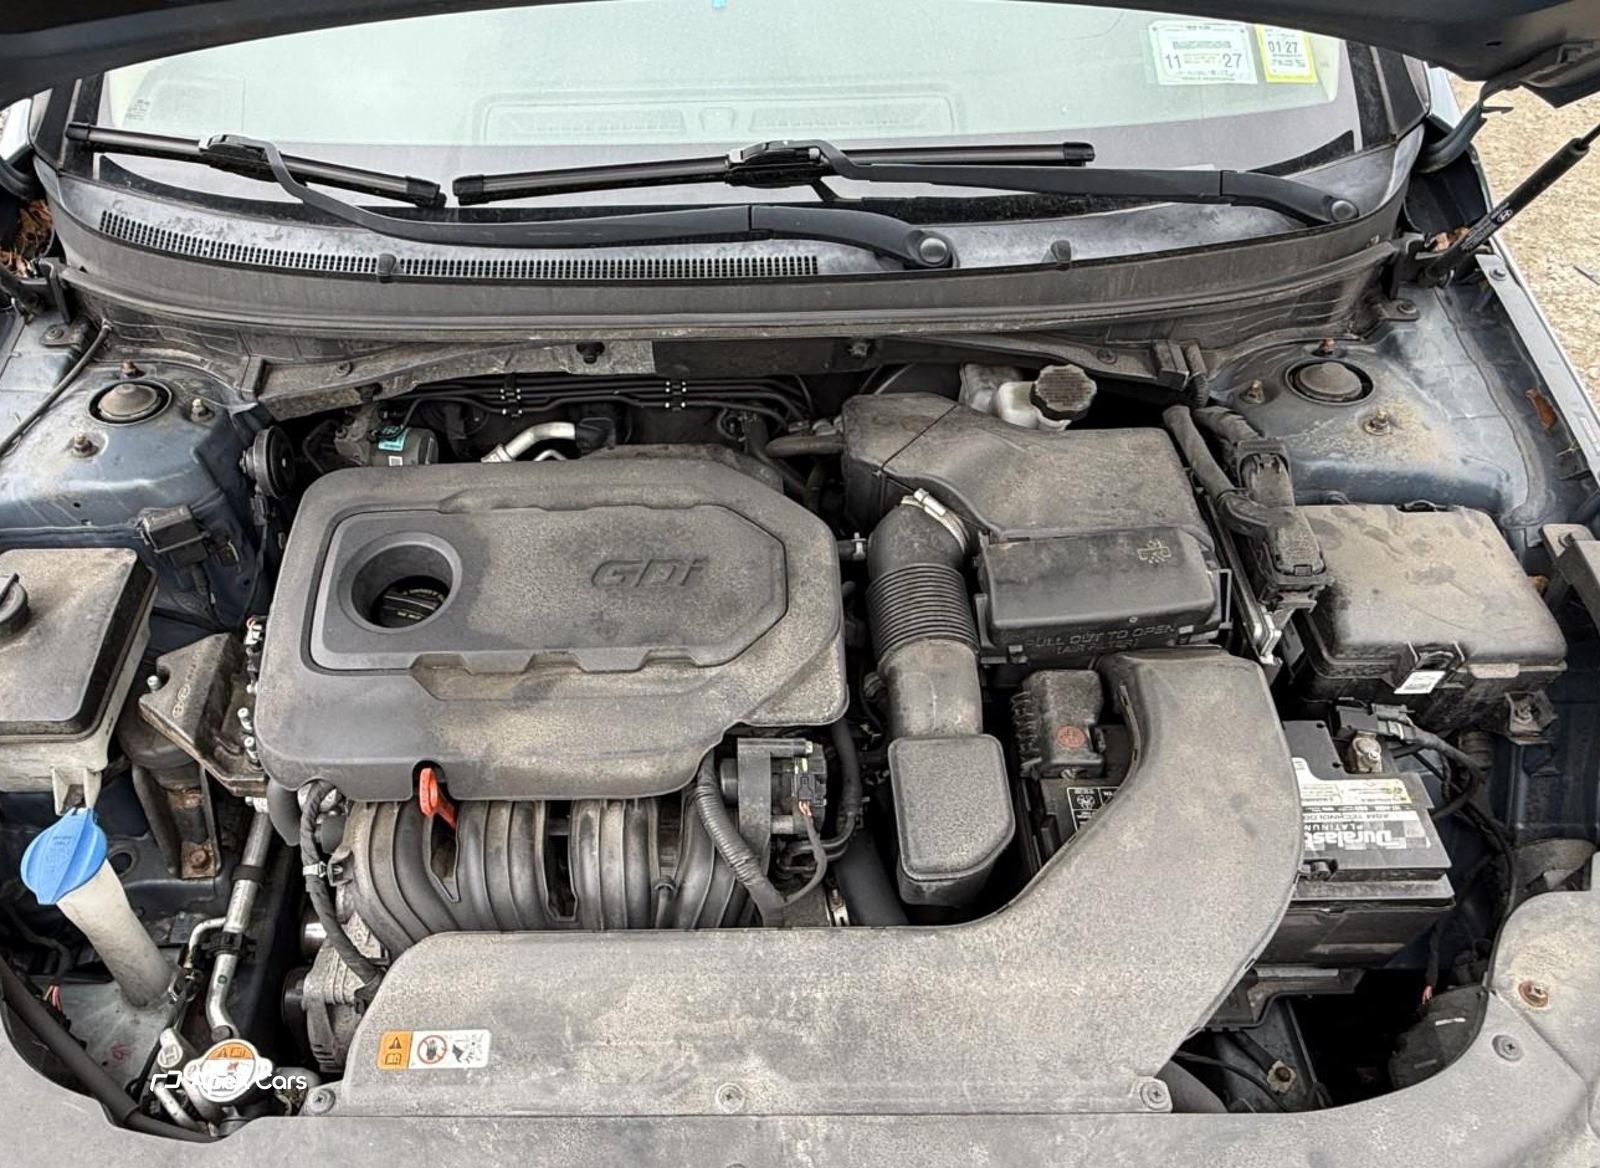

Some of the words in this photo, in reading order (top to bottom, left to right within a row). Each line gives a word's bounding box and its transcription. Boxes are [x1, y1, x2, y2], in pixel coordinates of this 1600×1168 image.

[1285, 41, 1298, 53] 27
[1165, 53, 1181, 69] 11
[1222, 53, 1242, 68] 27
[1069, 632, 1104, 645] OUT
[1108, 629, 1128, 640] TO
[1132, 624, 1175, 637] OPEN
[1304, 830, 1392, 850] Duralast
